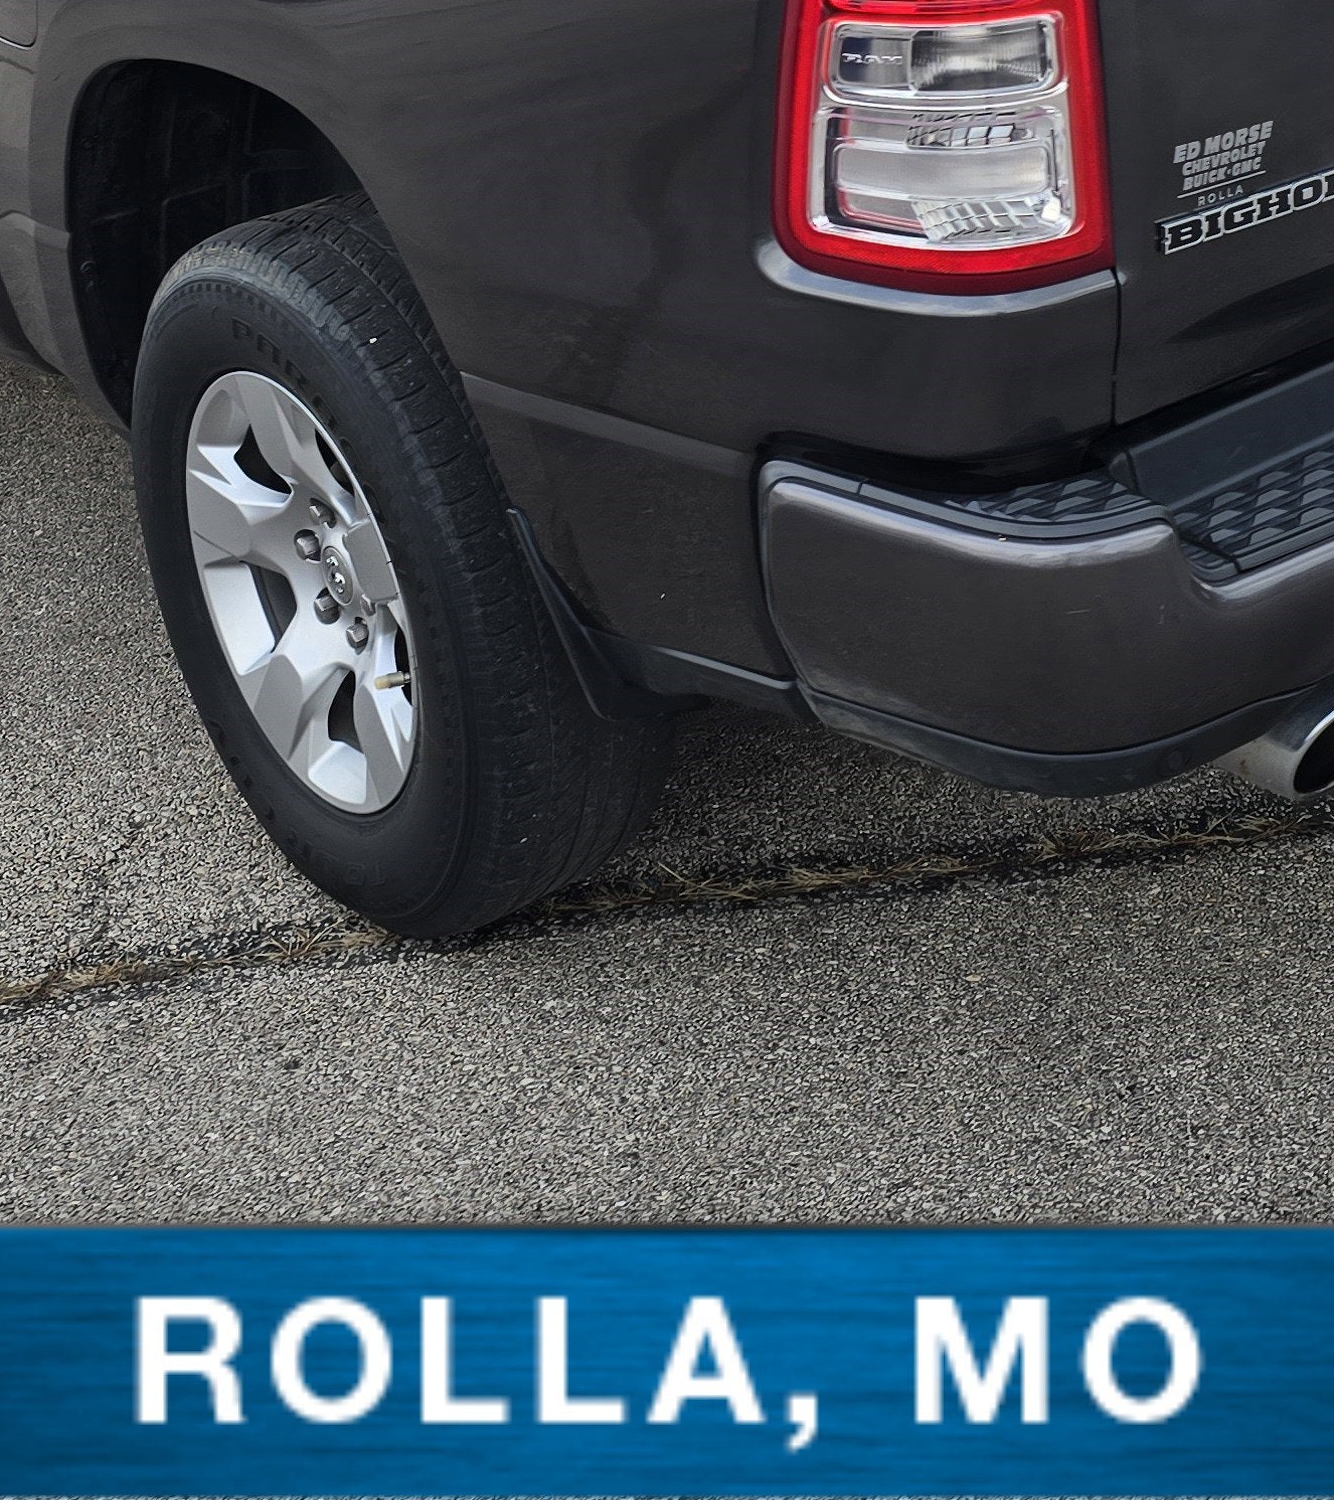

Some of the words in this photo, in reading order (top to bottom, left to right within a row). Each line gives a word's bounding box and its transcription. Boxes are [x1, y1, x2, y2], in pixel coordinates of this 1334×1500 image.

[1173, 140, 1202, 164] ED
[1203, 120, 1274, 156] MORSE
[1182, 140, 1267, 176] CHEVROLET
[1197, 184, 1244, 207] ROLLA
